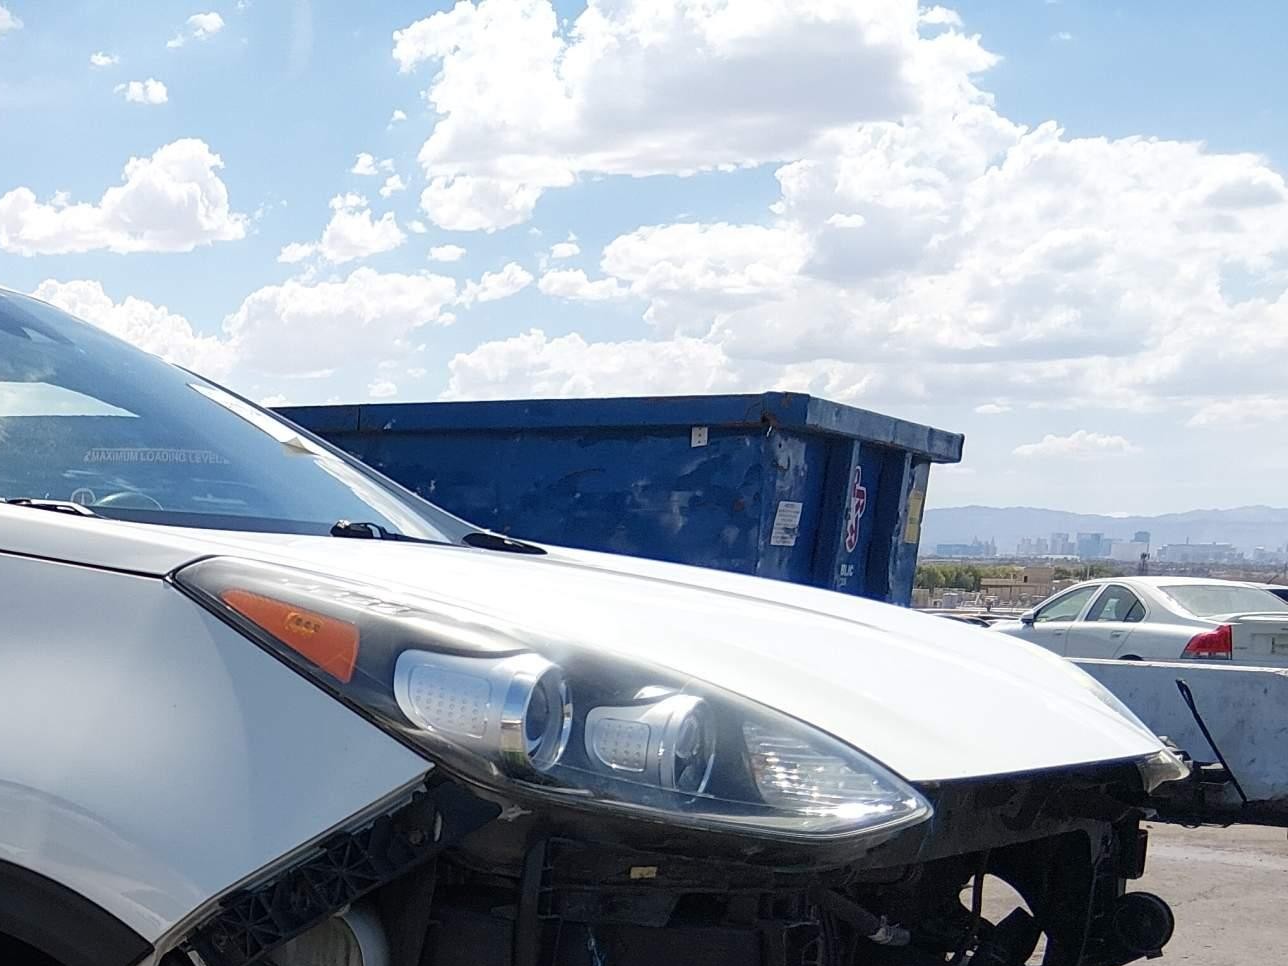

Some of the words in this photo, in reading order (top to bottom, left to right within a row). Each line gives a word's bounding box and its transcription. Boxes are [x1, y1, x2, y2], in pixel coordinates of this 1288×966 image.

[92, 450, 138, 462] MAXIMUM
[140, 451, 186, 463] LOADING
[189, 452, 224, 464] LEVEL
